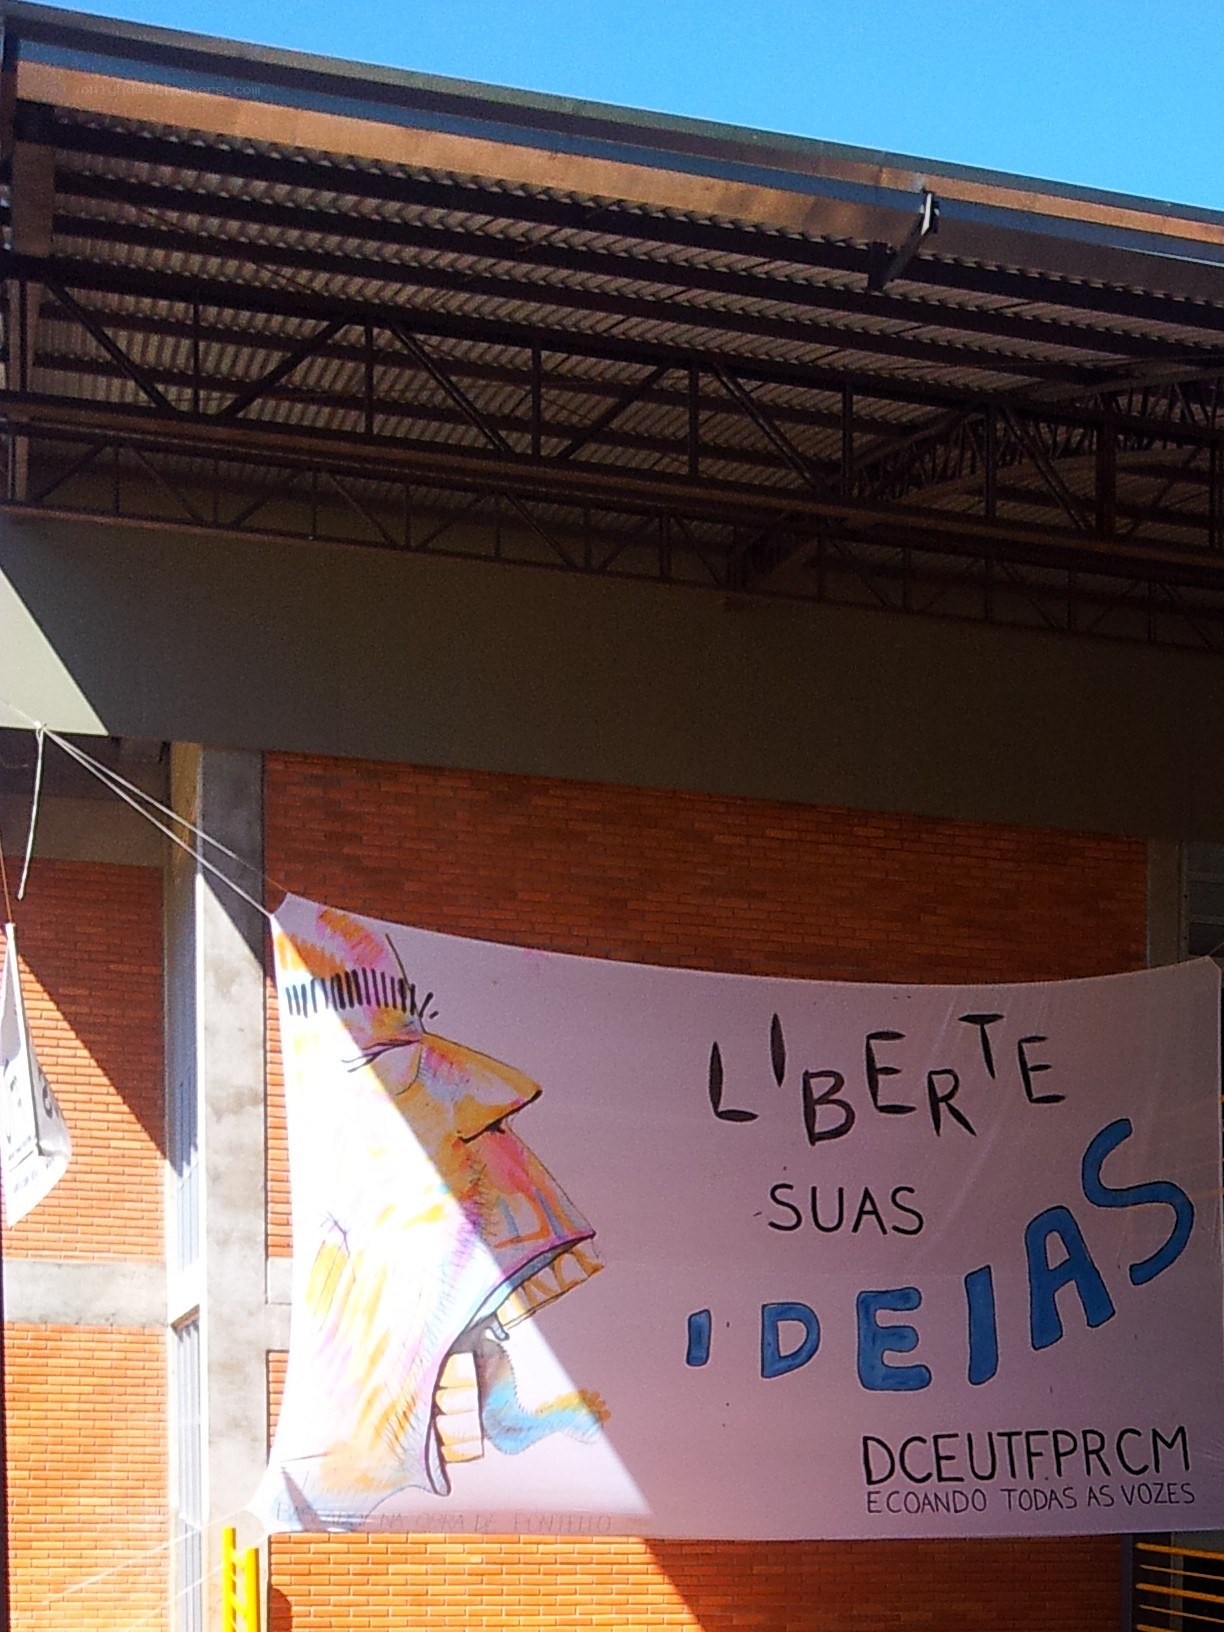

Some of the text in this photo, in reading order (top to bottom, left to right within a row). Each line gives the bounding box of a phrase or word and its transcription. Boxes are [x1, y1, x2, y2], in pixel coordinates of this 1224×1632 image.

[708, 1011, 1067, 1147] LIBERTE
[685, 1117, 1195, 1392] IDEIAS
[767, 1183, 925, 1236] SUAS
[866, 1482, 1196, 1514] ECOANDO TODAS AS VOZES
